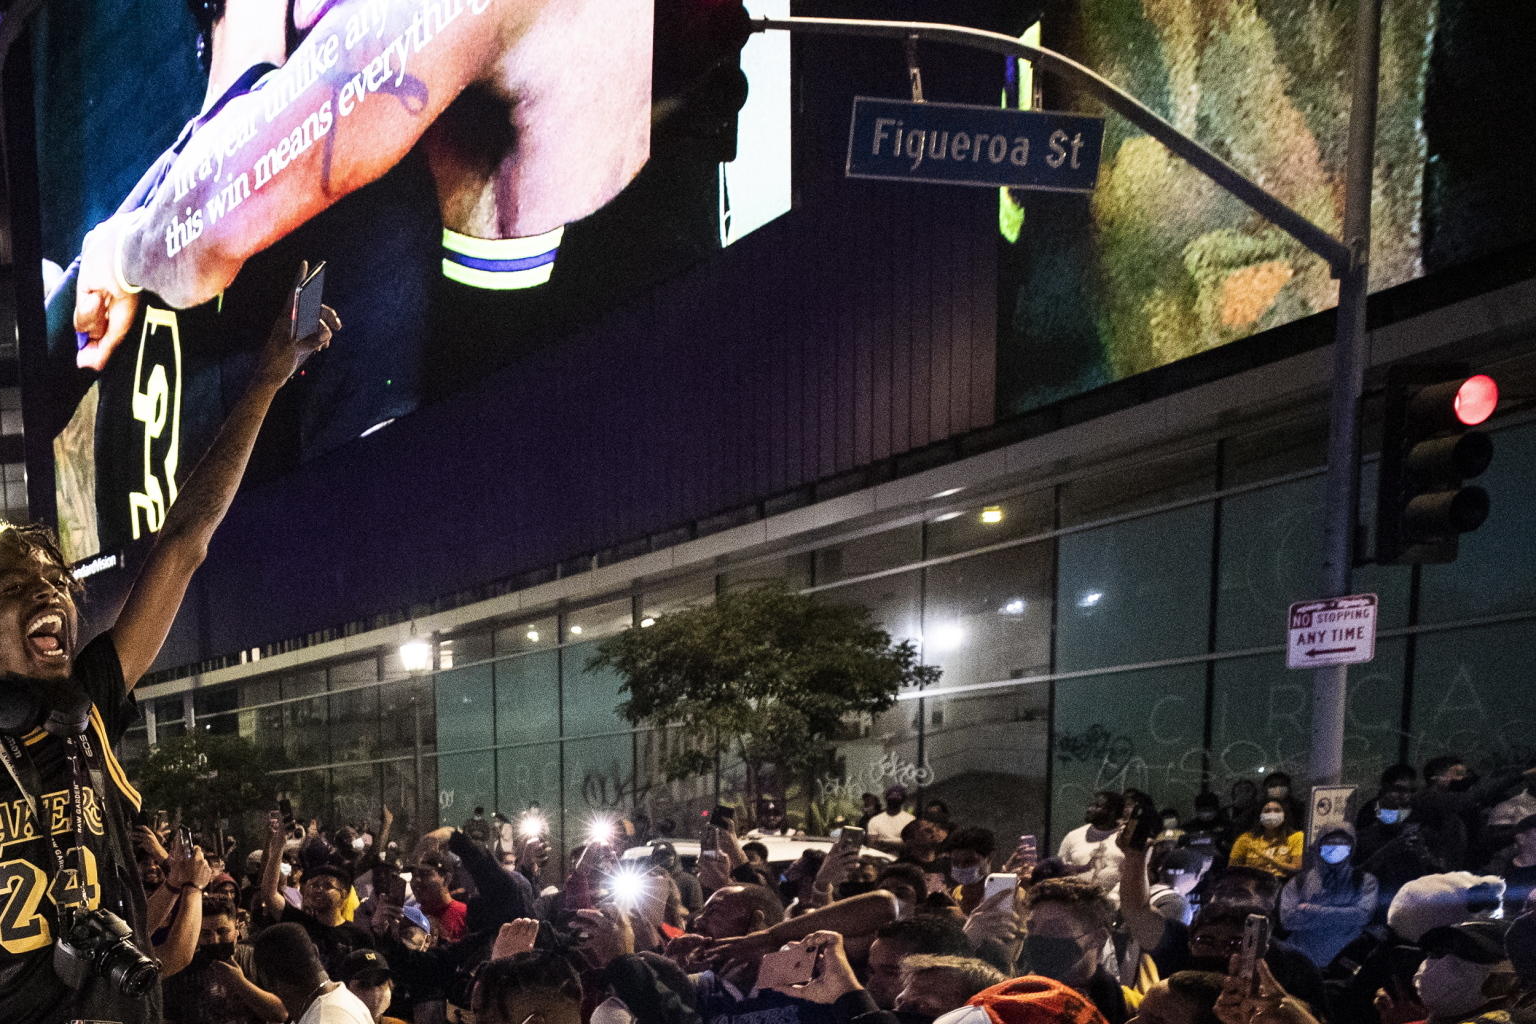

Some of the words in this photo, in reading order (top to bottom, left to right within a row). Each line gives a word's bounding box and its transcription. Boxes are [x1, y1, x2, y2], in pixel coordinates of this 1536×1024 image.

[213, 112, 259, 183] year
[263, 32, 340, 123] unlike
[871, 117, 1030, 173] Figueroa
[1045, 128, 1085, 170] St
[164, 206, 204, 258] this
[206, 172, 251, 225] win
[253, 100, 334, 190] means
[1292, 613, 1311, 627] NO
[1316, 608, 1370, 624] STOPPING
[1296, 630, 1326, 646] ANY
[1332, 625, 1365, 642] TIME
